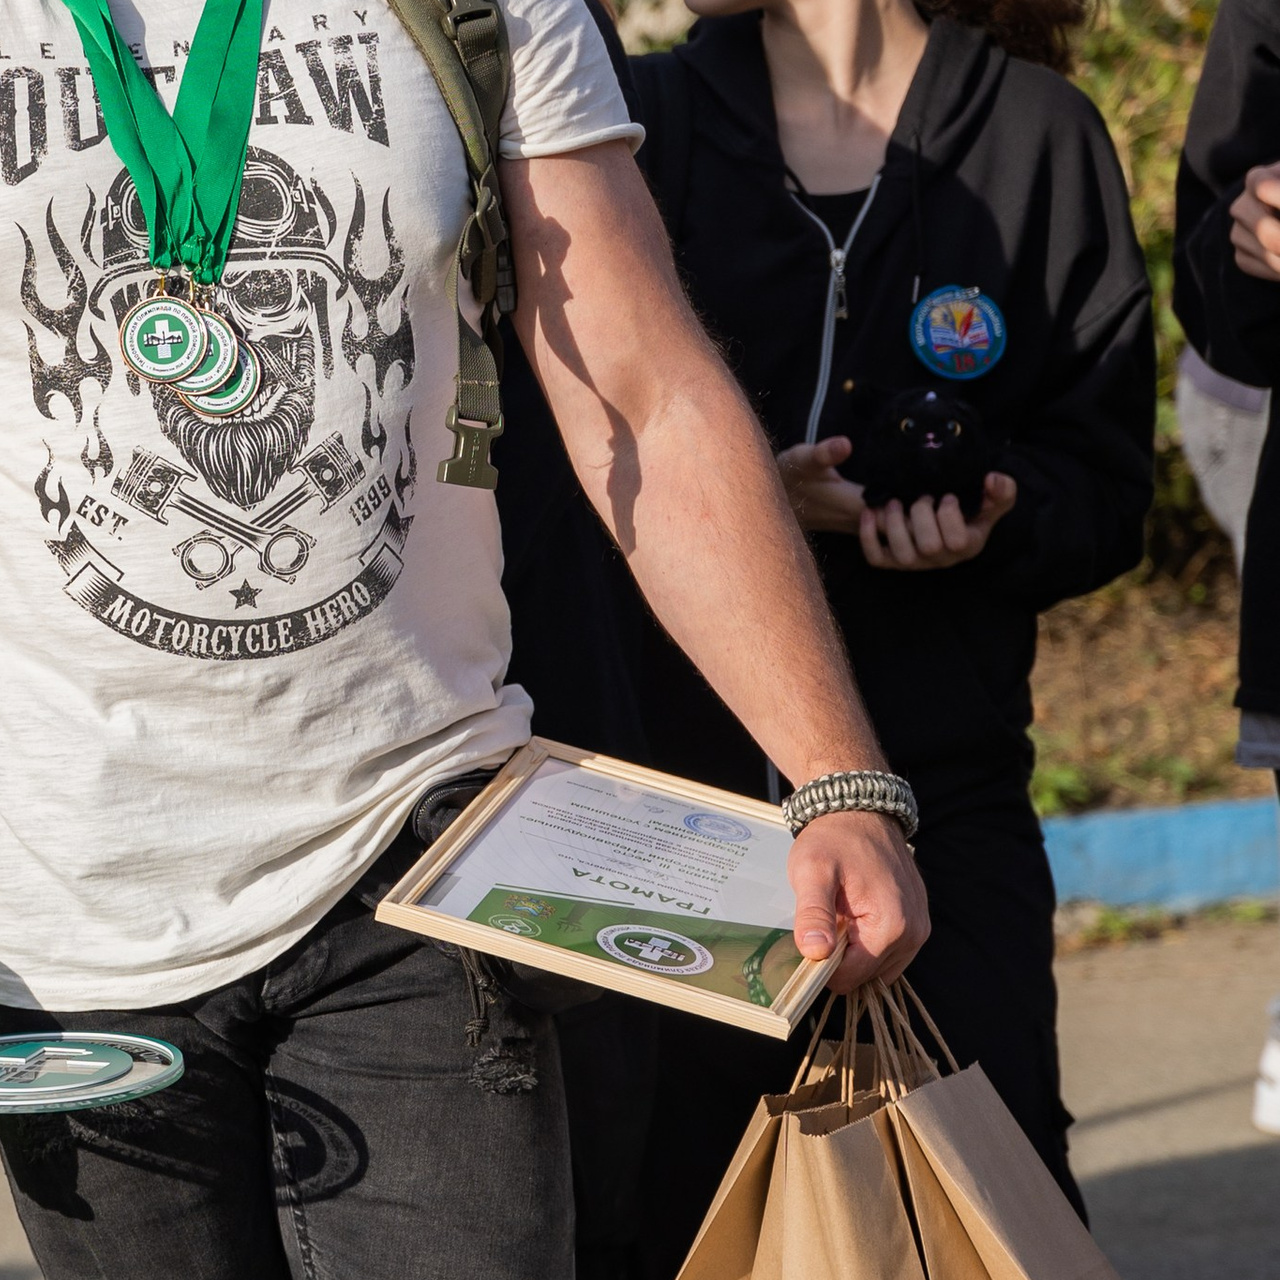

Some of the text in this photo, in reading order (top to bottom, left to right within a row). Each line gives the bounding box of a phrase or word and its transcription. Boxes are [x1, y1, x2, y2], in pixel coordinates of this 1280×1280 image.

[75, 494, 129, 541] EST.
[102, 580, 371, 656] MOTORCYCLE HERO
[569, 801, 641, 825] успешным
[517, 814, 645, 855] «Неравнодушные»
[647, 818, 749, 851] выступлением!
[652, 826, 746, 857] Поздравляем
[611, 848, 652, 863] место
[647, 852, 718, 876] категории
[567, 867, 710, 915] ГРАМОТА
